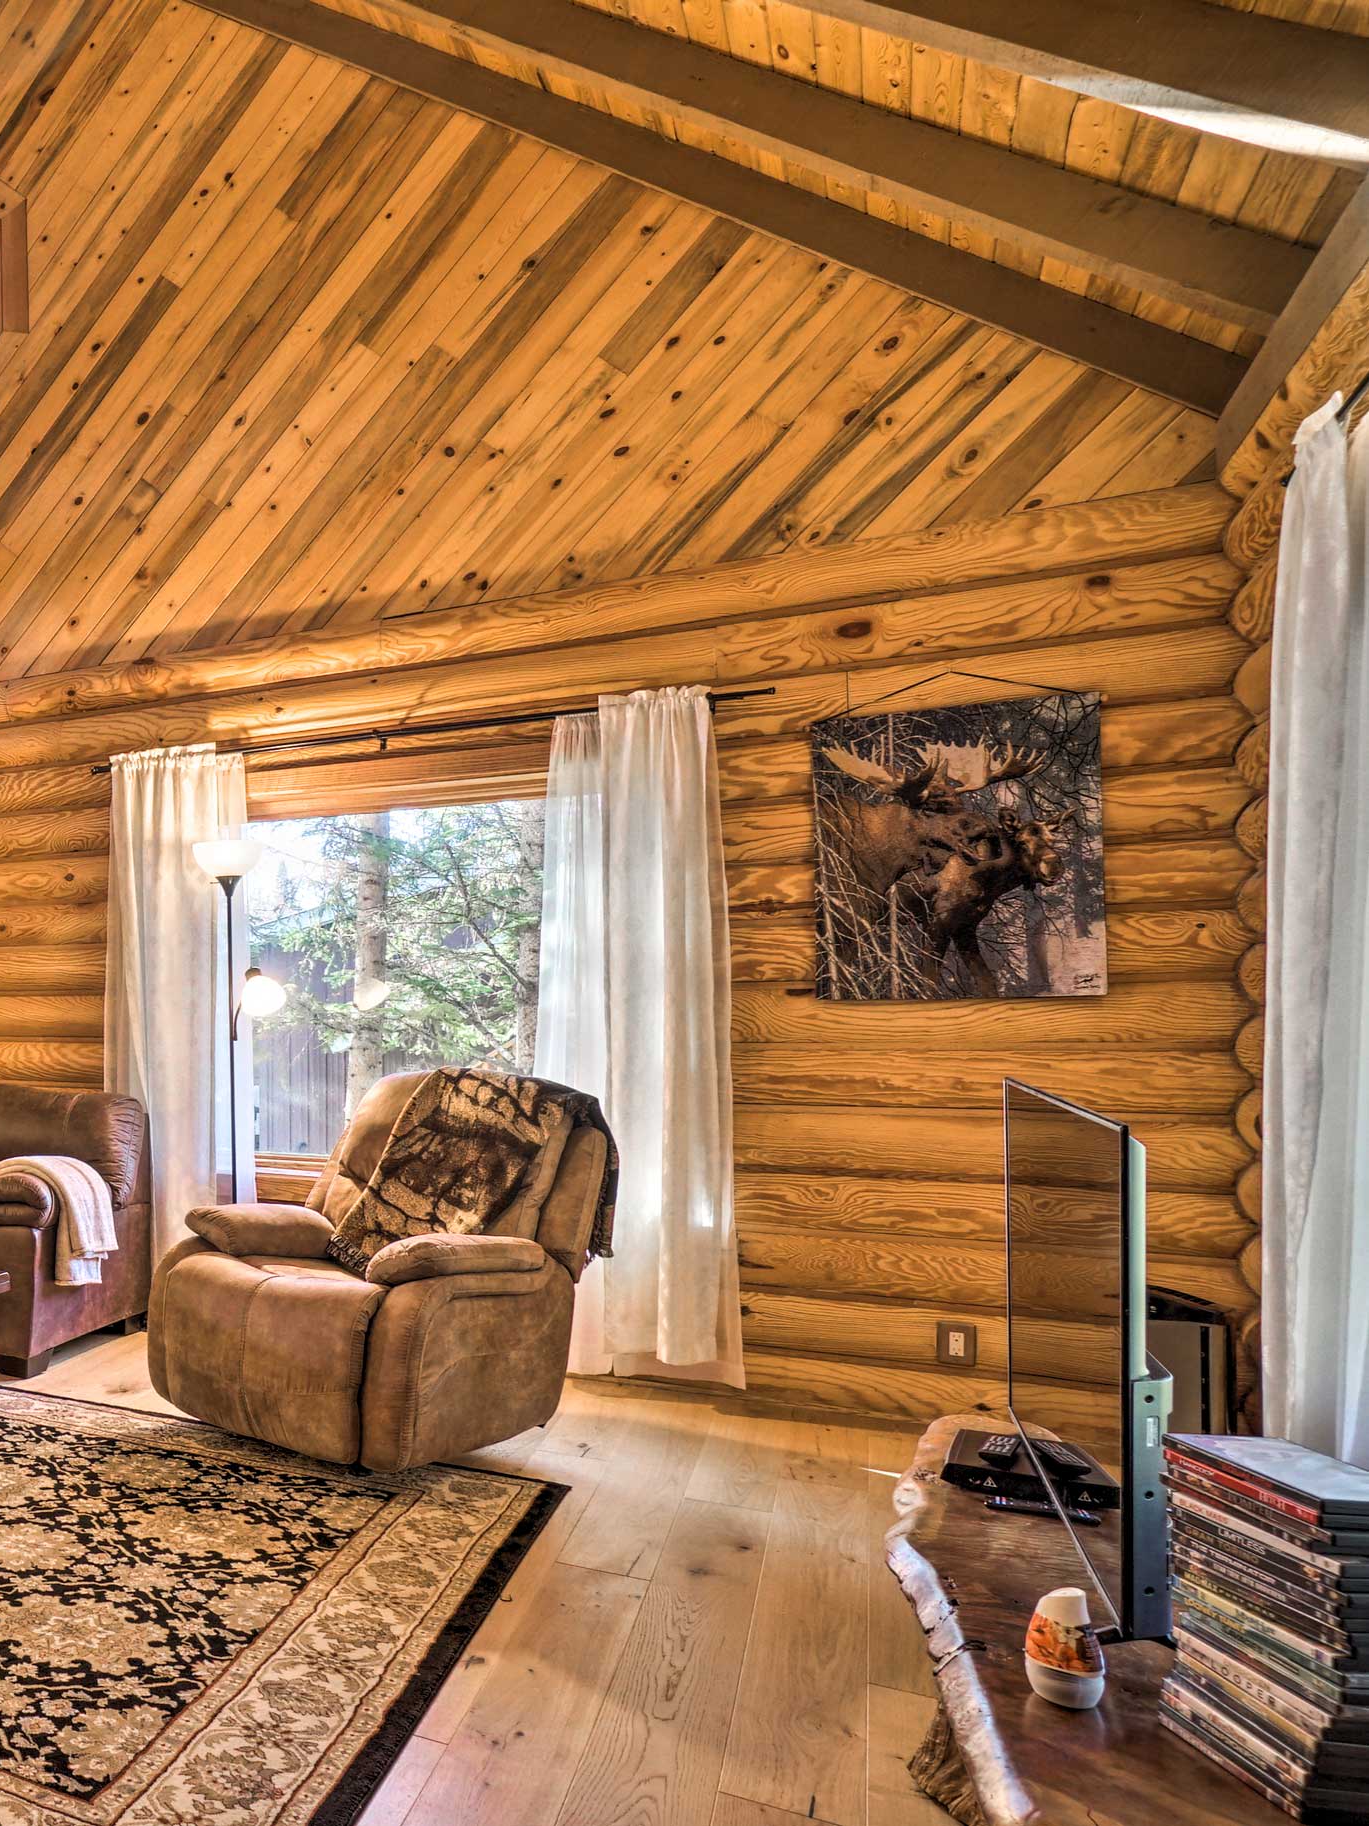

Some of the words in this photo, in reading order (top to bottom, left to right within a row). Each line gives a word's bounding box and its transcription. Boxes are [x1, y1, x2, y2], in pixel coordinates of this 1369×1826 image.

[1184, 1523, 1213, 1546] GRAN
[1217, 1525, 1265, 1557] LIMITLESS
[1209, 1546, 1276, 1587] TERMINATOR
[1210, 1658, 1276, 1708] LOOPER
